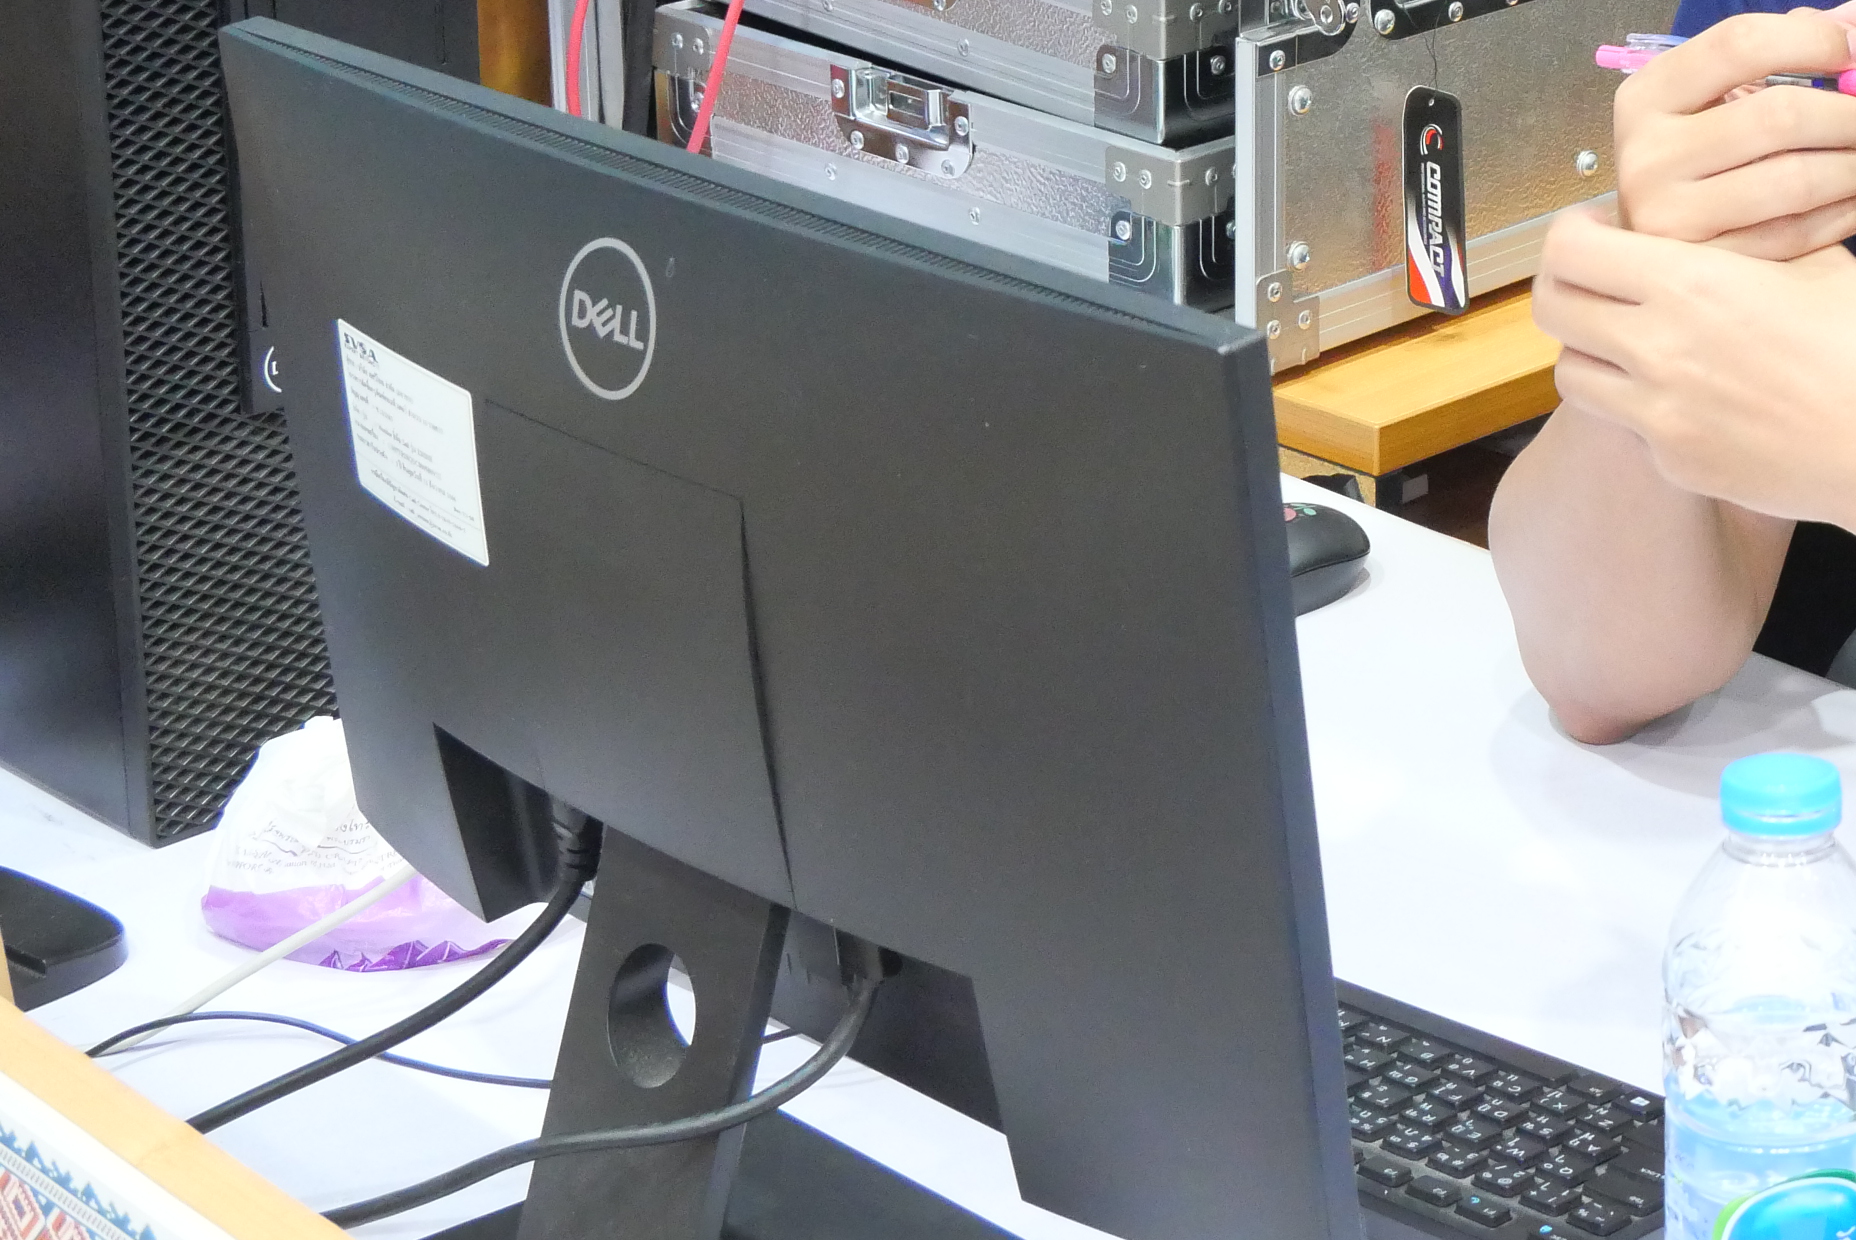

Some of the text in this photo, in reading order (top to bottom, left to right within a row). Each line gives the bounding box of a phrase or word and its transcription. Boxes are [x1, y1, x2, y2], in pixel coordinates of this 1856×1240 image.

[1426, 161, 1445, 278] COMPACT
[572, 289, 645, 350] DELL
[1553, 1102, 1568, 1110] X
